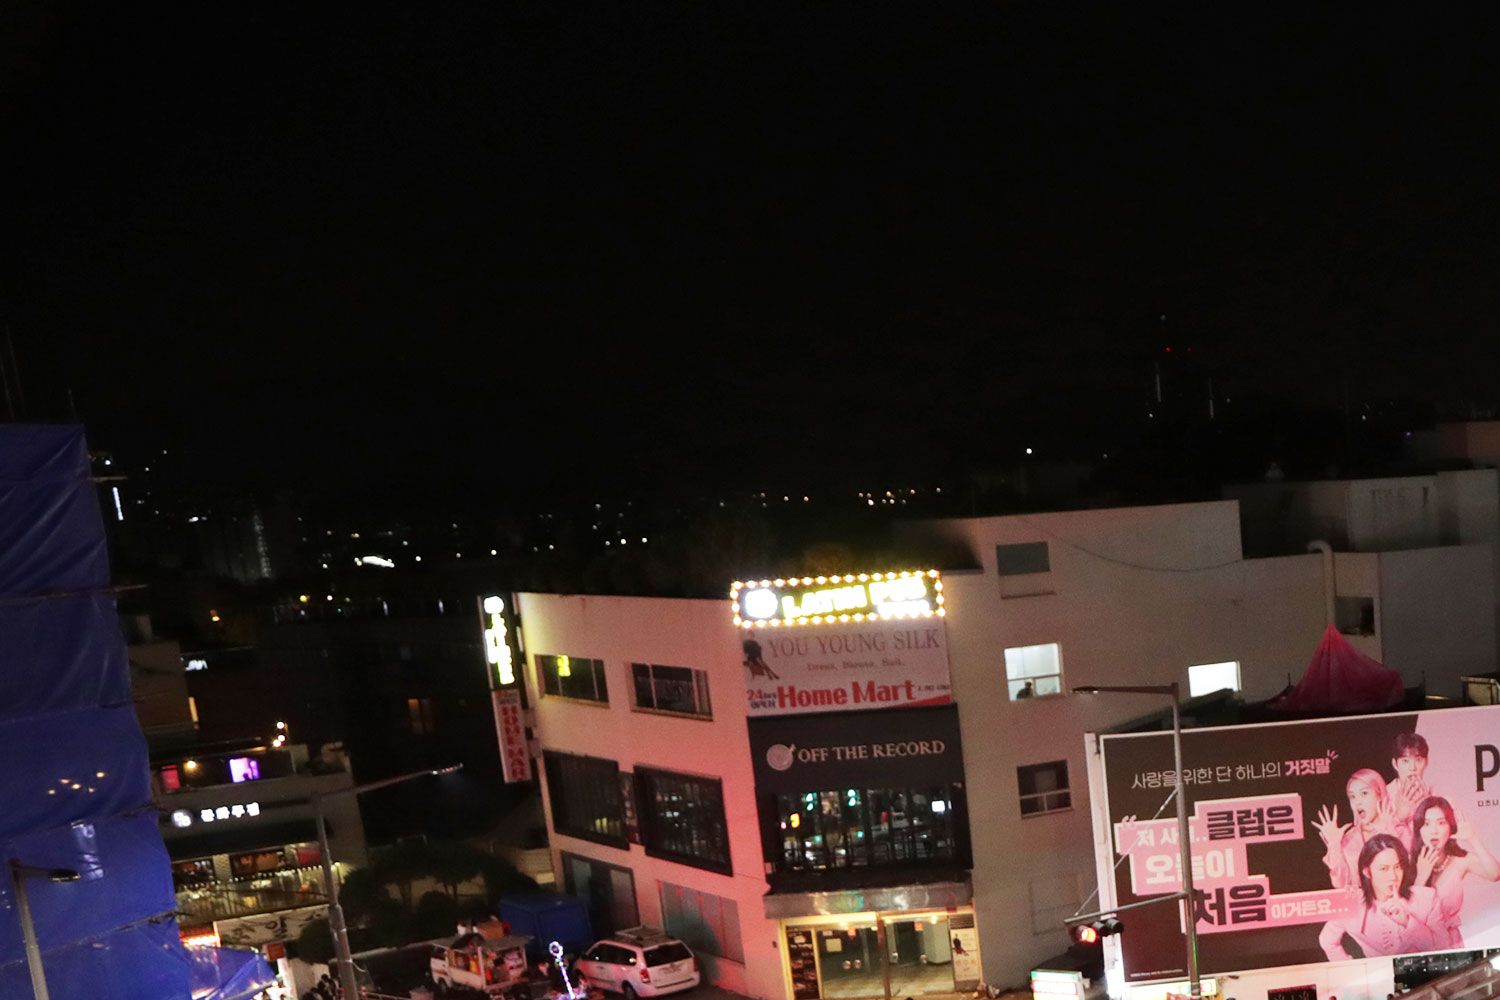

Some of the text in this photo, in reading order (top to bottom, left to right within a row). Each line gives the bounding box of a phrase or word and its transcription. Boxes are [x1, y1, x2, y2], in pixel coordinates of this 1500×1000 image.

[768, 628, 940, 658] YOU YOUNG SILK
[777, 679, 917, 709] Home Mart
[798, 740, 946, 763] OFF THE RECORD
[1182, 766, 1213, 785] 위한
[1215, 765, 1232, 782] 단
[1235, 760, 1281, 781] 하나의
[1284, 757, 1332, 775] 거짓말
[1206, 804, 1295, 841] 클럽은
[1135, 829, 1155, 848] 저
